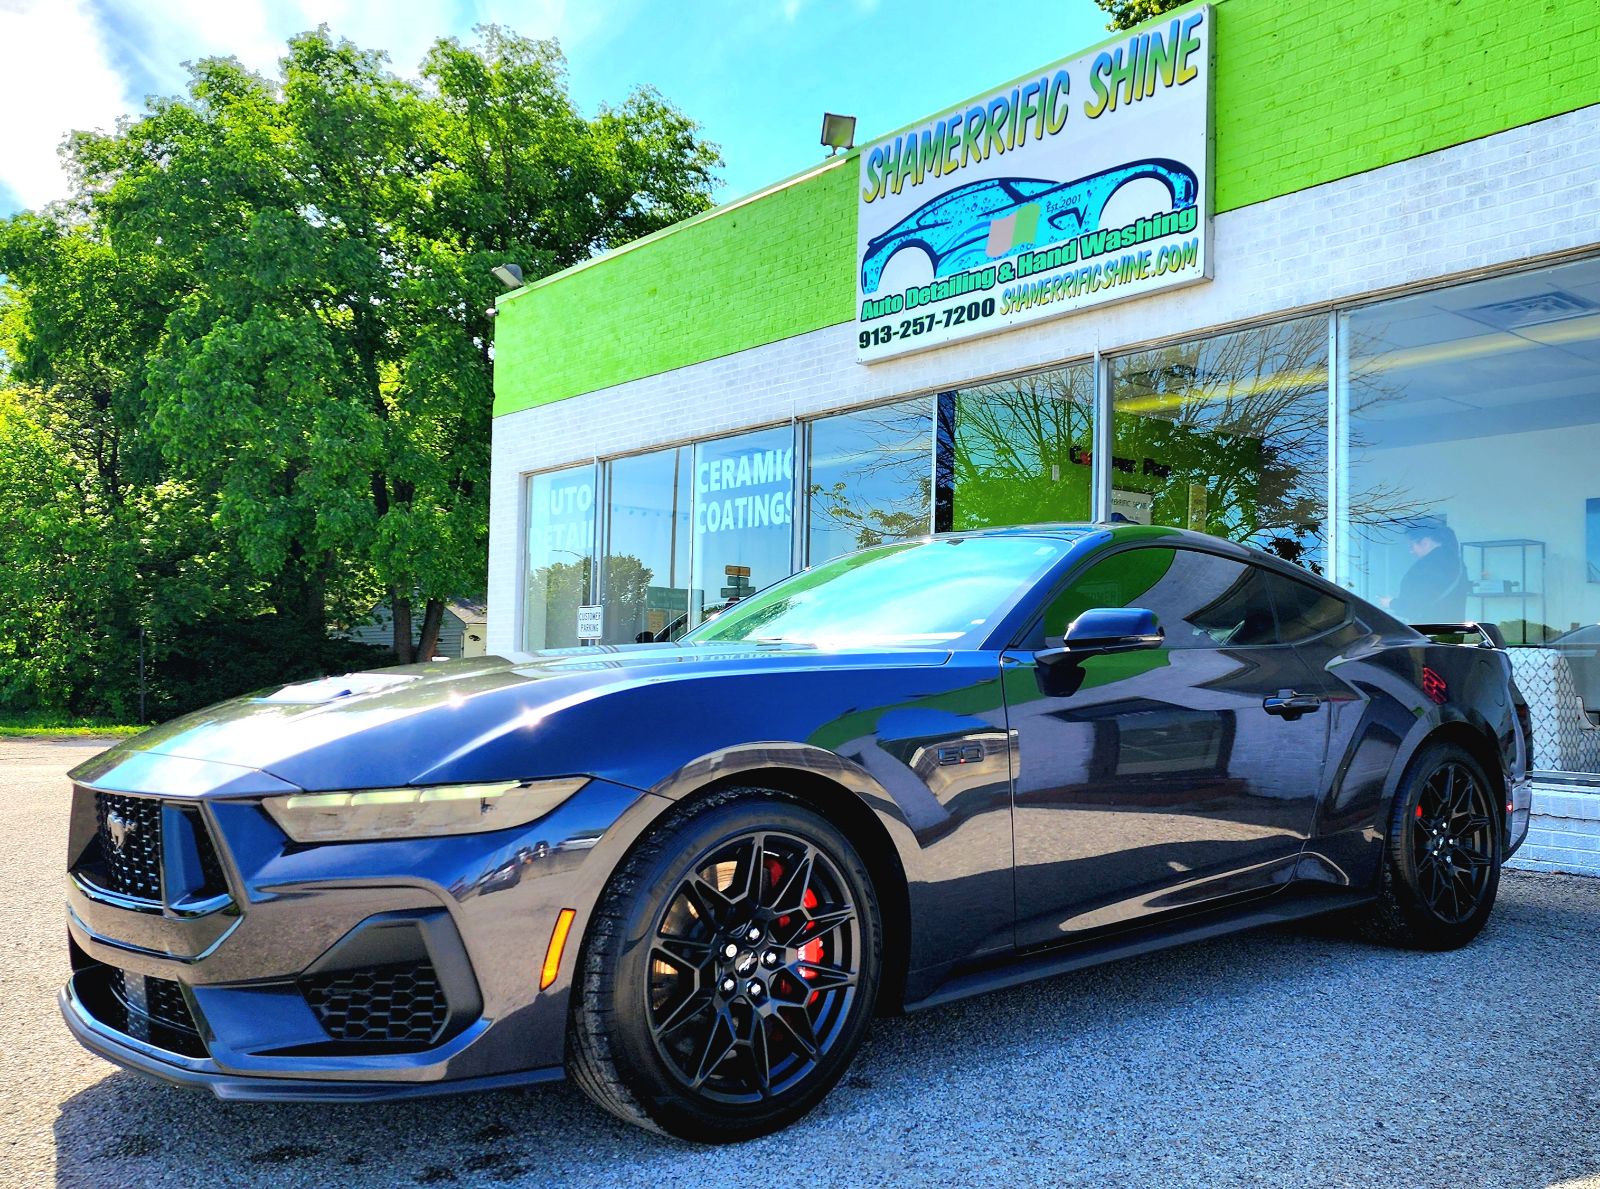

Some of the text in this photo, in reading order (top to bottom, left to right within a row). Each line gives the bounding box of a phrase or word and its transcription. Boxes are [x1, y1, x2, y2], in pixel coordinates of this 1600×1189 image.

[863, 12, 1203, 203] SHAMERRIFIC SHINE
[861, 205, 1198, 322] Auto Detailing & Hand Washing
[859, 237, 1198, 349] 913-257-7200 SHAMERRIFICSHINE.COM
[698, 447, 792, 493] CERAMIC
[545, 484, 592, 516] UTO
[697, 490, 792, 534] COATINGS
[579, 611, 601, 621] CUSTOMER
[580, 623, 599, 632] PARKING
